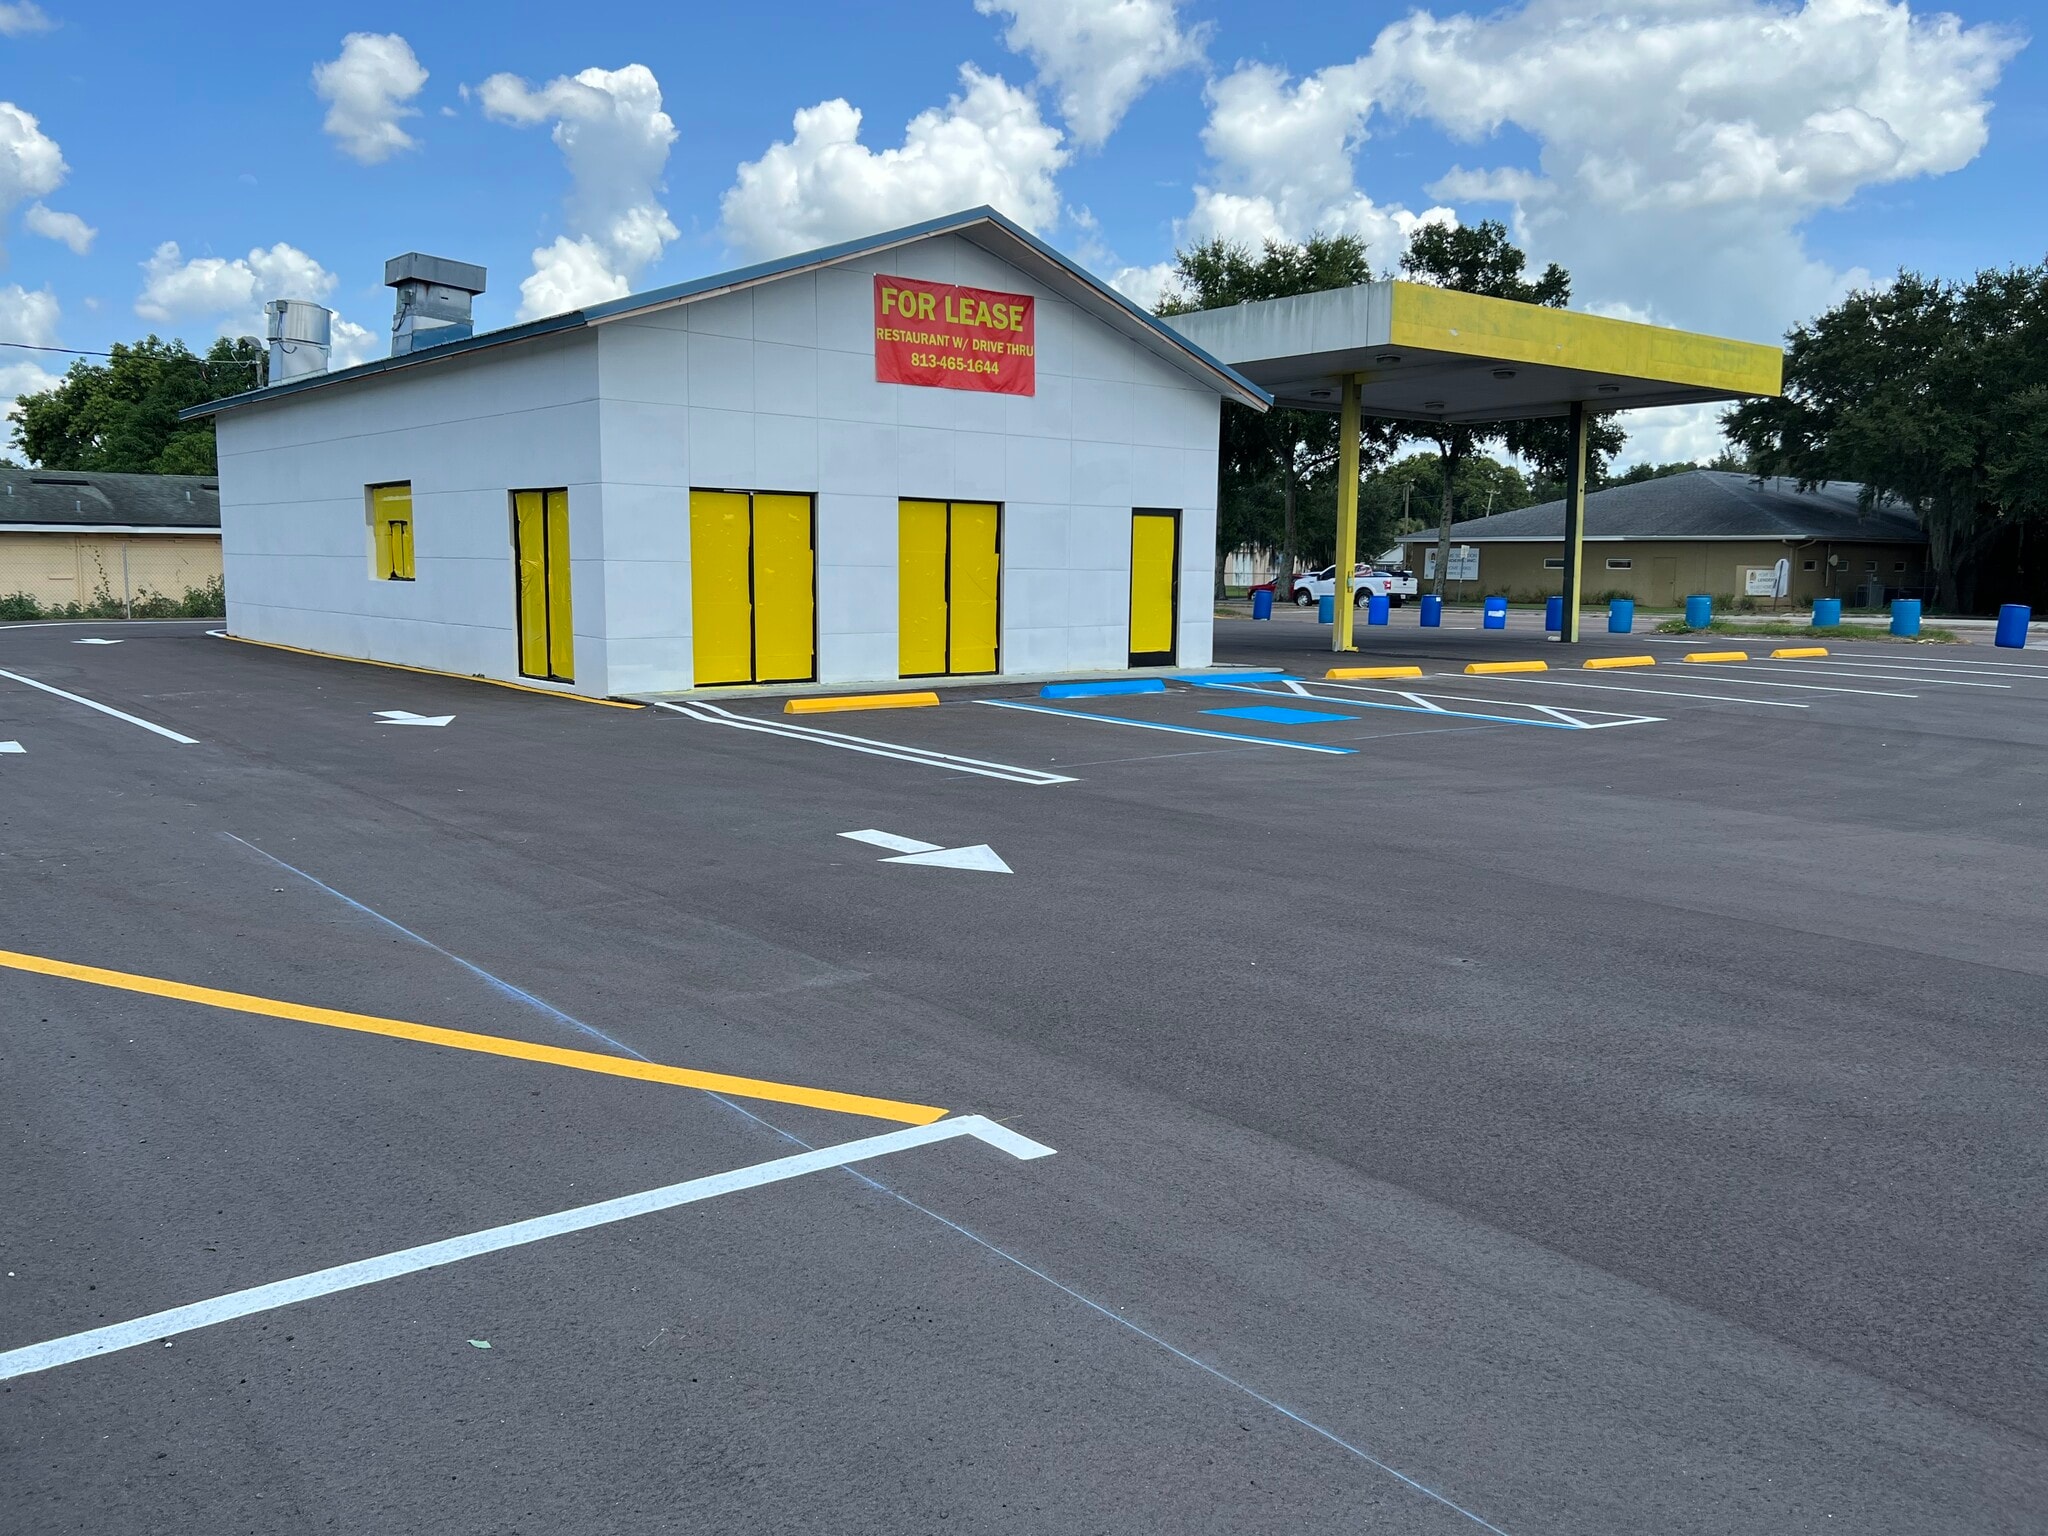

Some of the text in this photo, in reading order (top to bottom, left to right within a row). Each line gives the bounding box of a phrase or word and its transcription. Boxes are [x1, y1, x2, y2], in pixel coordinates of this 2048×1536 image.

[882, 288, 1023, 332] FOR LEASE
[876, 328, 1034, 357] RESTAURANT W/ DRIVE THRU
[911, 353, 999, 374] 813-465-1644
